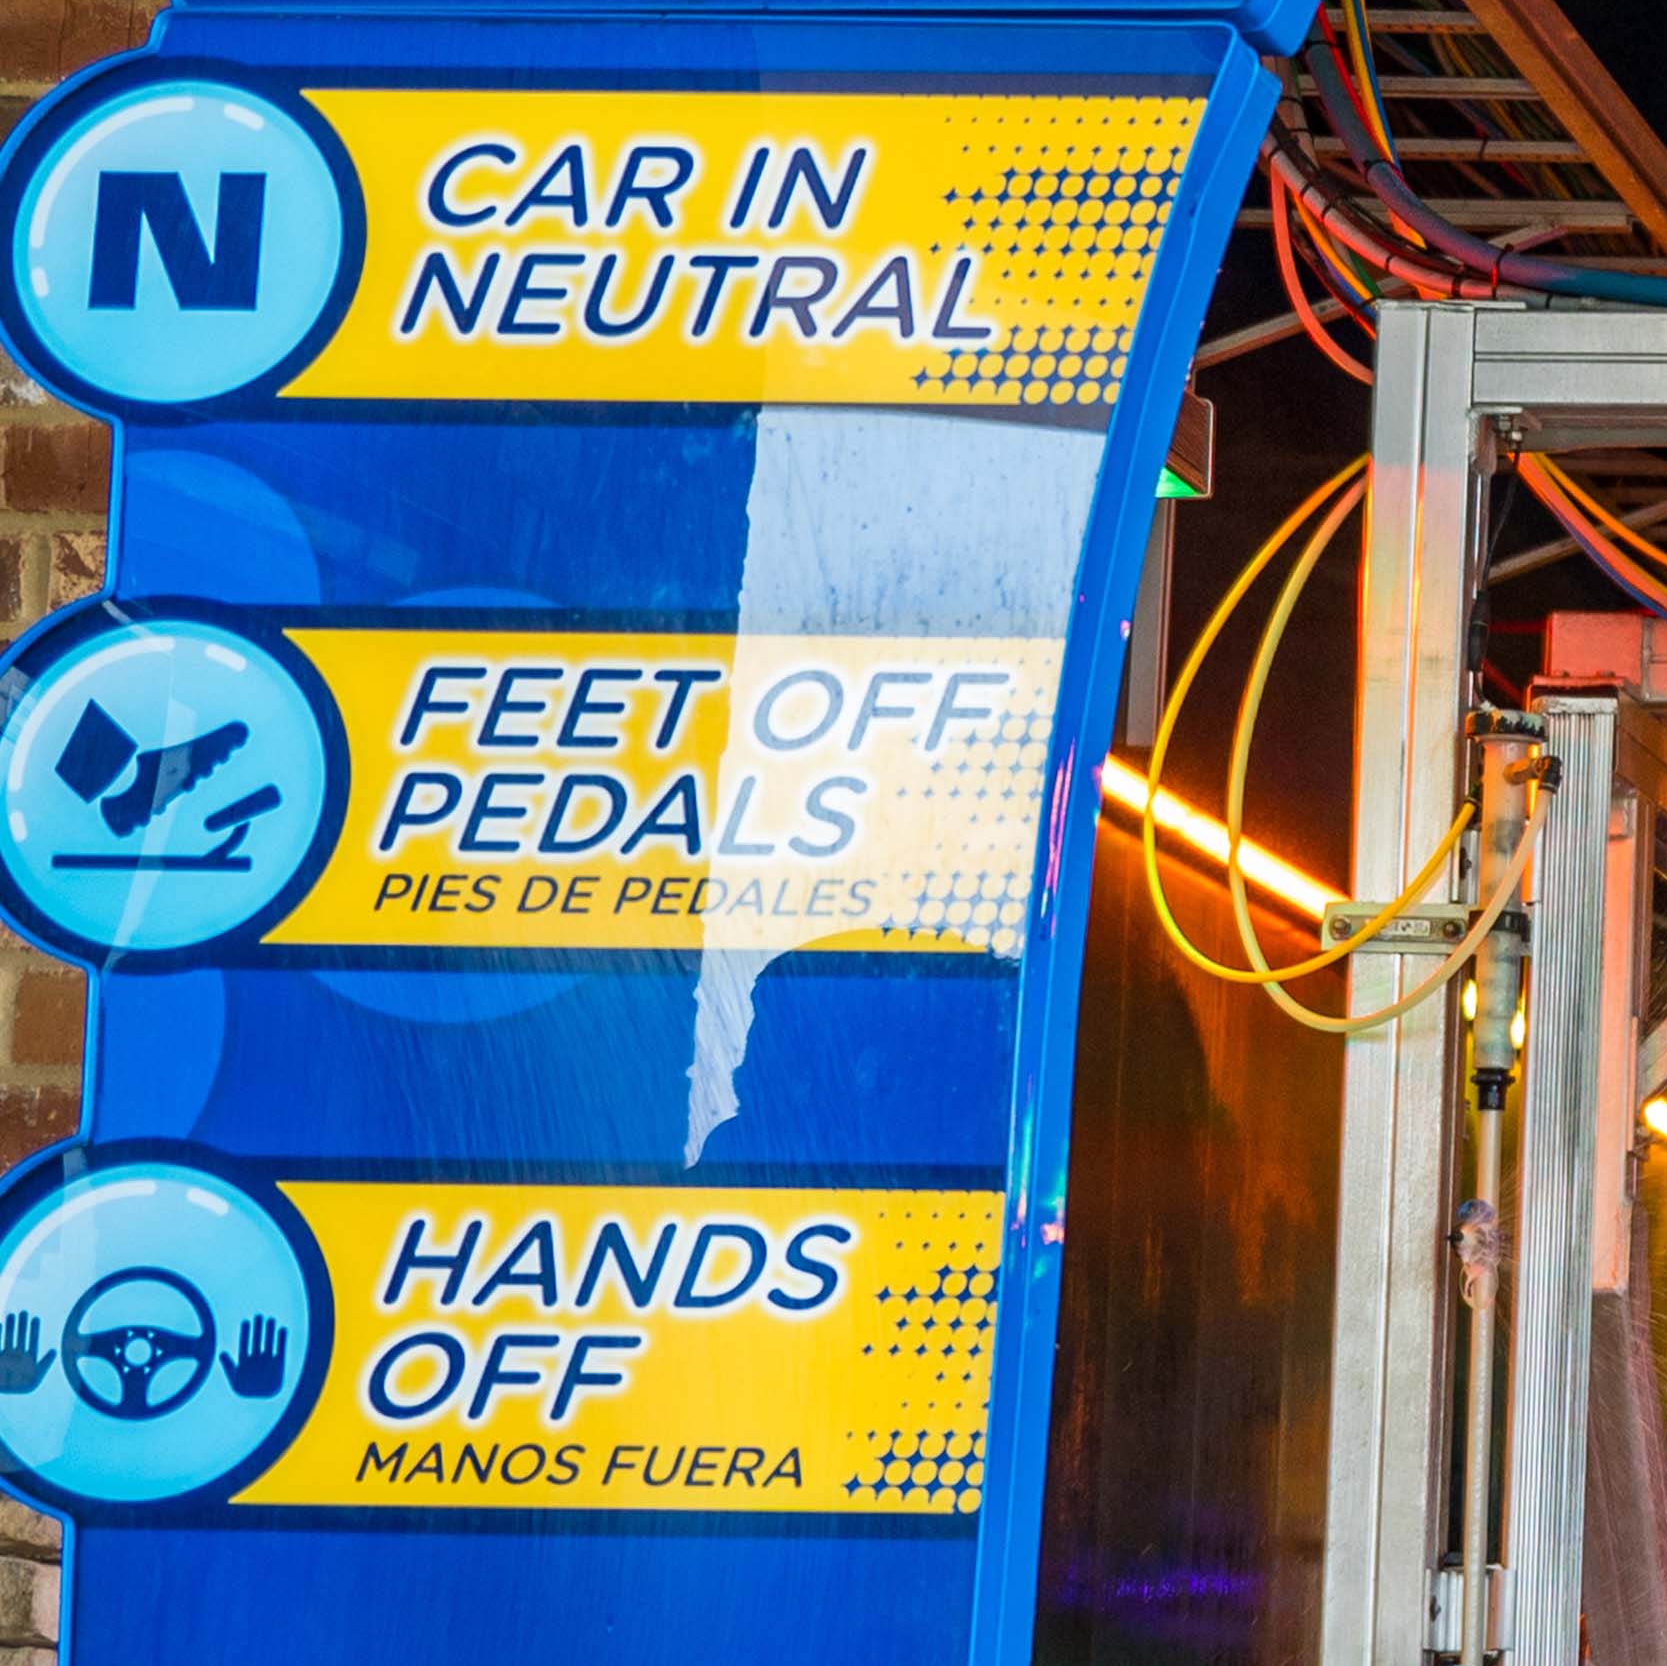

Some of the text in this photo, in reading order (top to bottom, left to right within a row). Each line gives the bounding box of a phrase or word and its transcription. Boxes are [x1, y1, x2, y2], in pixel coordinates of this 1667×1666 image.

[427, 142, 868, 230] CAR IN
[86, 170, 269, 313] N
[399, 251, 992, 339] NEUTRAL
[399, 665, 1010, 752] FEET OFF
[377, 770, 868, 858] PEDALS
[373, 872, 877, 917] PIES DE PEDALES
[382, 1218, 853, 1312] HANDS
[367, 1330, 643, 1422] OFF
[354, 1440, 804, 1489] MANOS FUERA
